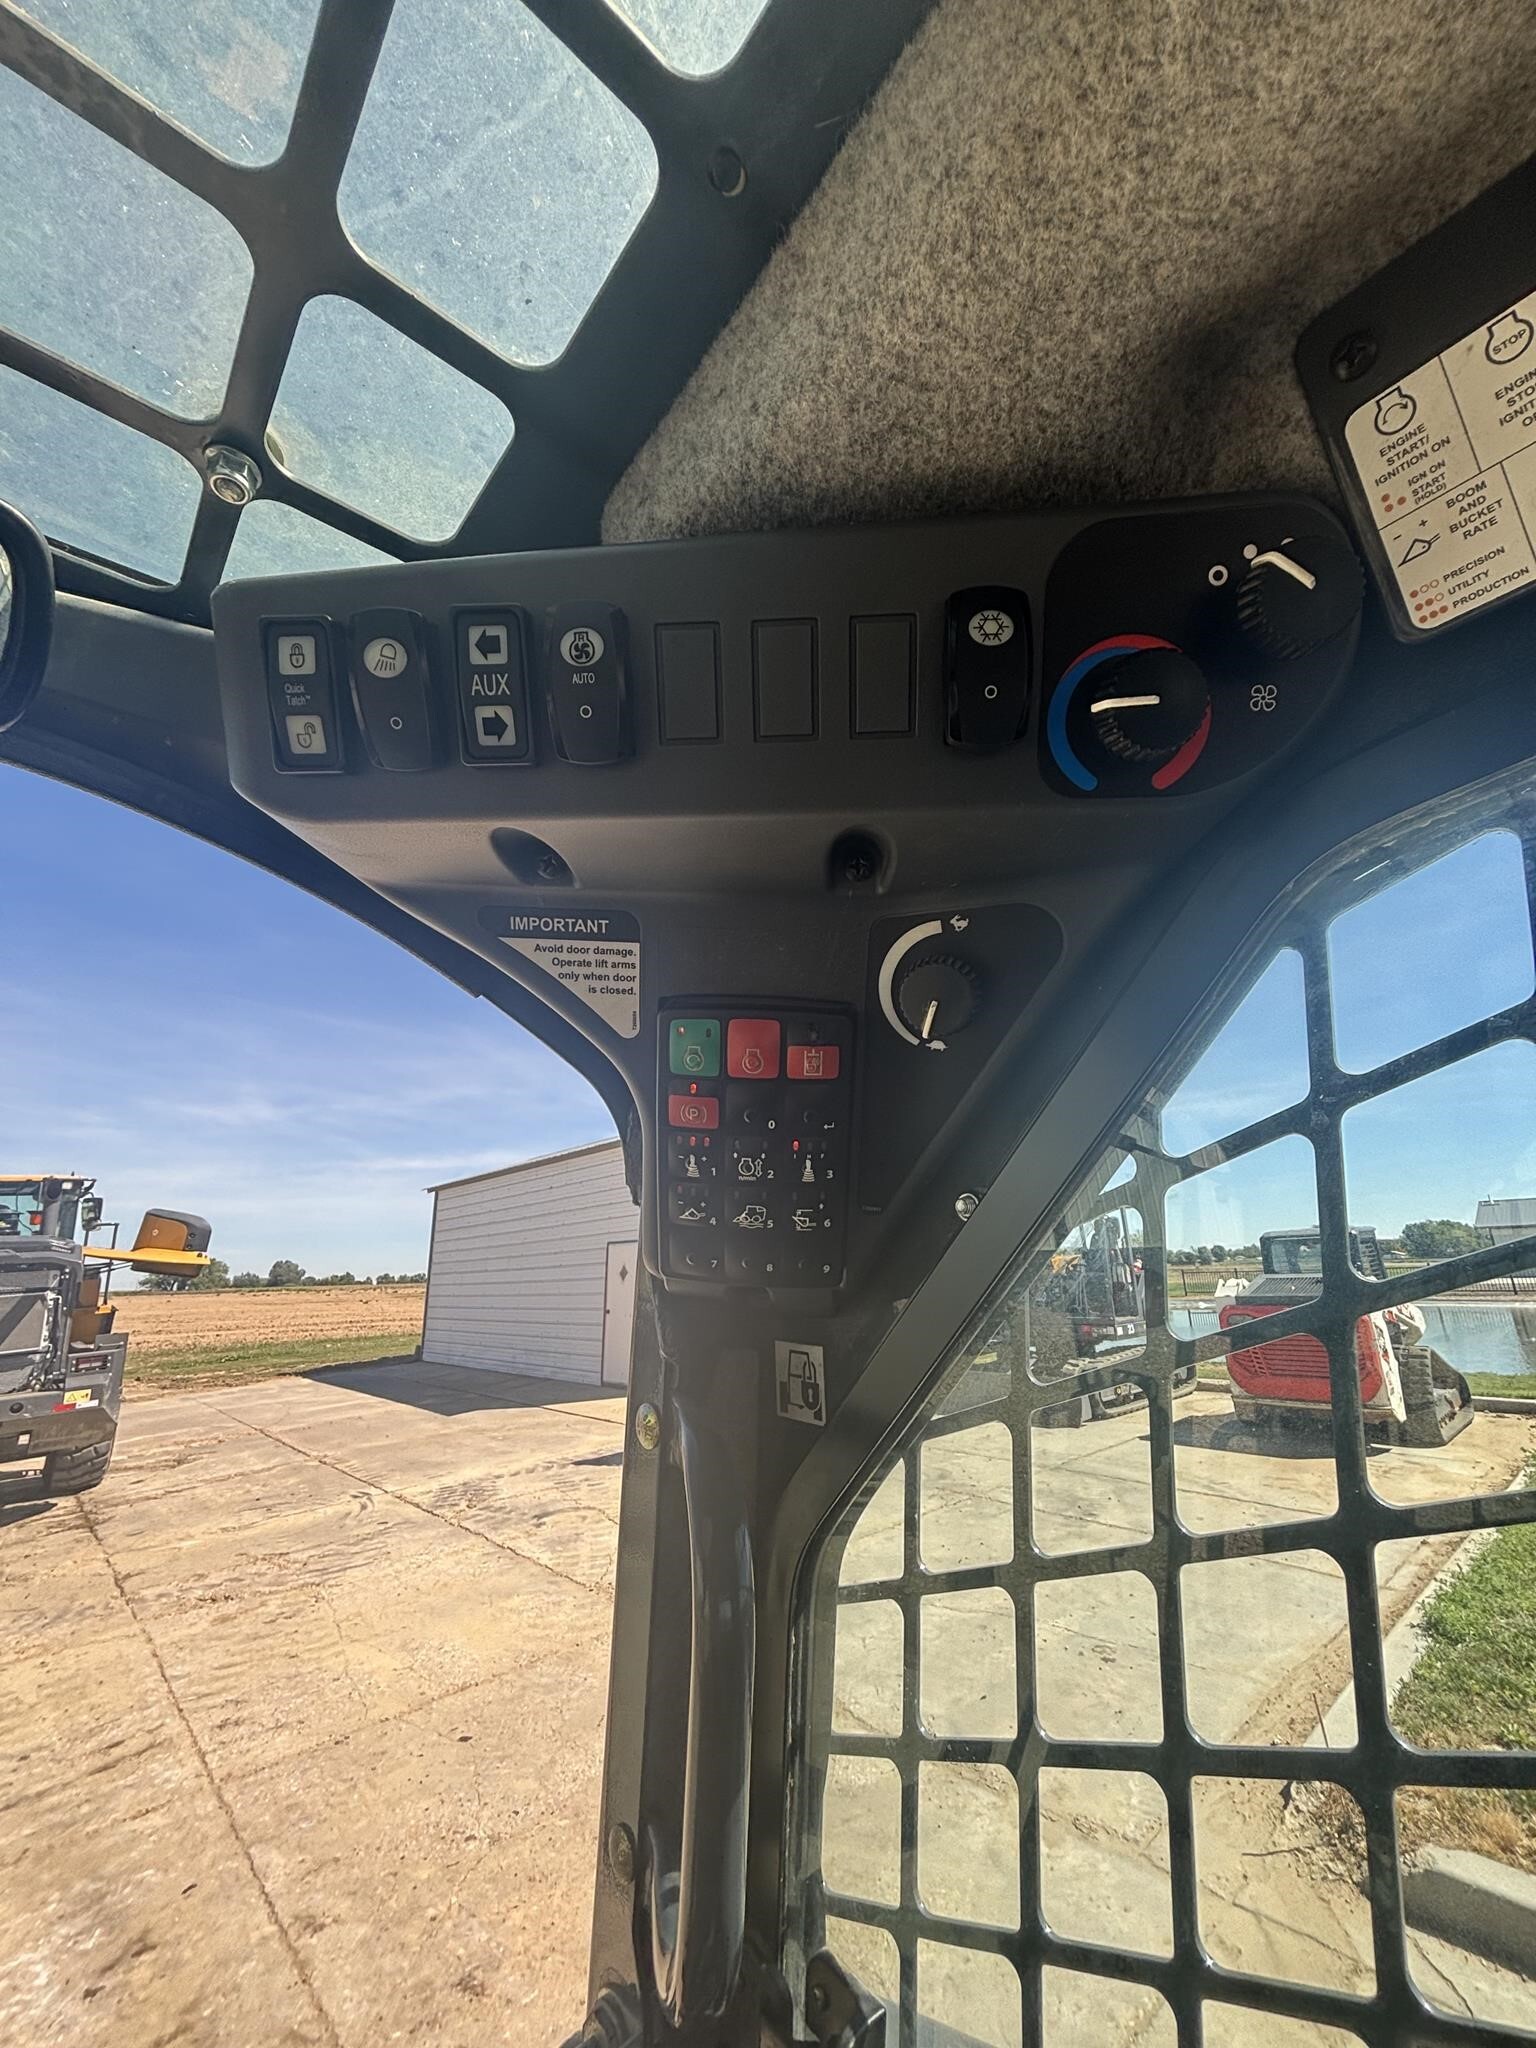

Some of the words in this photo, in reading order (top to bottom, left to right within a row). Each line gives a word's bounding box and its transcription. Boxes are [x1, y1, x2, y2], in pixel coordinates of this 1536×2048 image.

[1493, 329, 1527, 355] STOP
[1507, 382, 1536, 407] STO
[1380, 423, 1427, 457] ENGINE
[1386, 434, 1430, 466] START/
[1374, 449, 1429, 487] IGNITION
[1431, 435, 1451, 453] ON
[1407, 470, 1427, 487] IGN
[1429, 459, 1446, 474] ON
[1412, 472, 1446, 497] START
[1414, 482, 1447, 505] (HOLD)
[1446, 480, 1487, 509] BOOM
[1459, 495, 1487, 515] AND
[1449, 498, 1503, 534] BUCKET
[1463, 515, 1498, 540] RATE
[1443, 546, 1505, 582] PRECISION
[1448, 569, 1489, 595] UTILITY
[1453, 567, 1529, 608] PRODUCTION
[471, 673, 510, 696] AUX
[572, 672, 596, 684] AUTO
[284, 683, 305, 693] Quick
[510, 916, 609, 934] IMPORTANT
[534, 943, 564, 954] Avoid
[566, 945, 590, 954] door
[593, 947, 637, 957] damage.
[552, 957, 592, 969] Operate
[595, 960, 609, 969] lift
[611, 962, 636, 970] arms
[558, 972, 580, 983] only
[583, 973, 610, 982] when
[613, 973, 637, 983] door
[588, 984, 597, 994] is
[600, 985, 637, 996] closed.
[711, 1167, 716, 1176] 1
[767, 1170, 774, 1179] 2
[826, 1169, 834, 1179] 3
[709, 1216, 716, 1226] 4
[767, 1219, 774, 1229] 5
[824, 1218, 831, 1228] 6
[711, 1259, 718, 1268] 7
[766, 1263, 773, 1272] 8
[823, 1264, 831, 1274] 9
